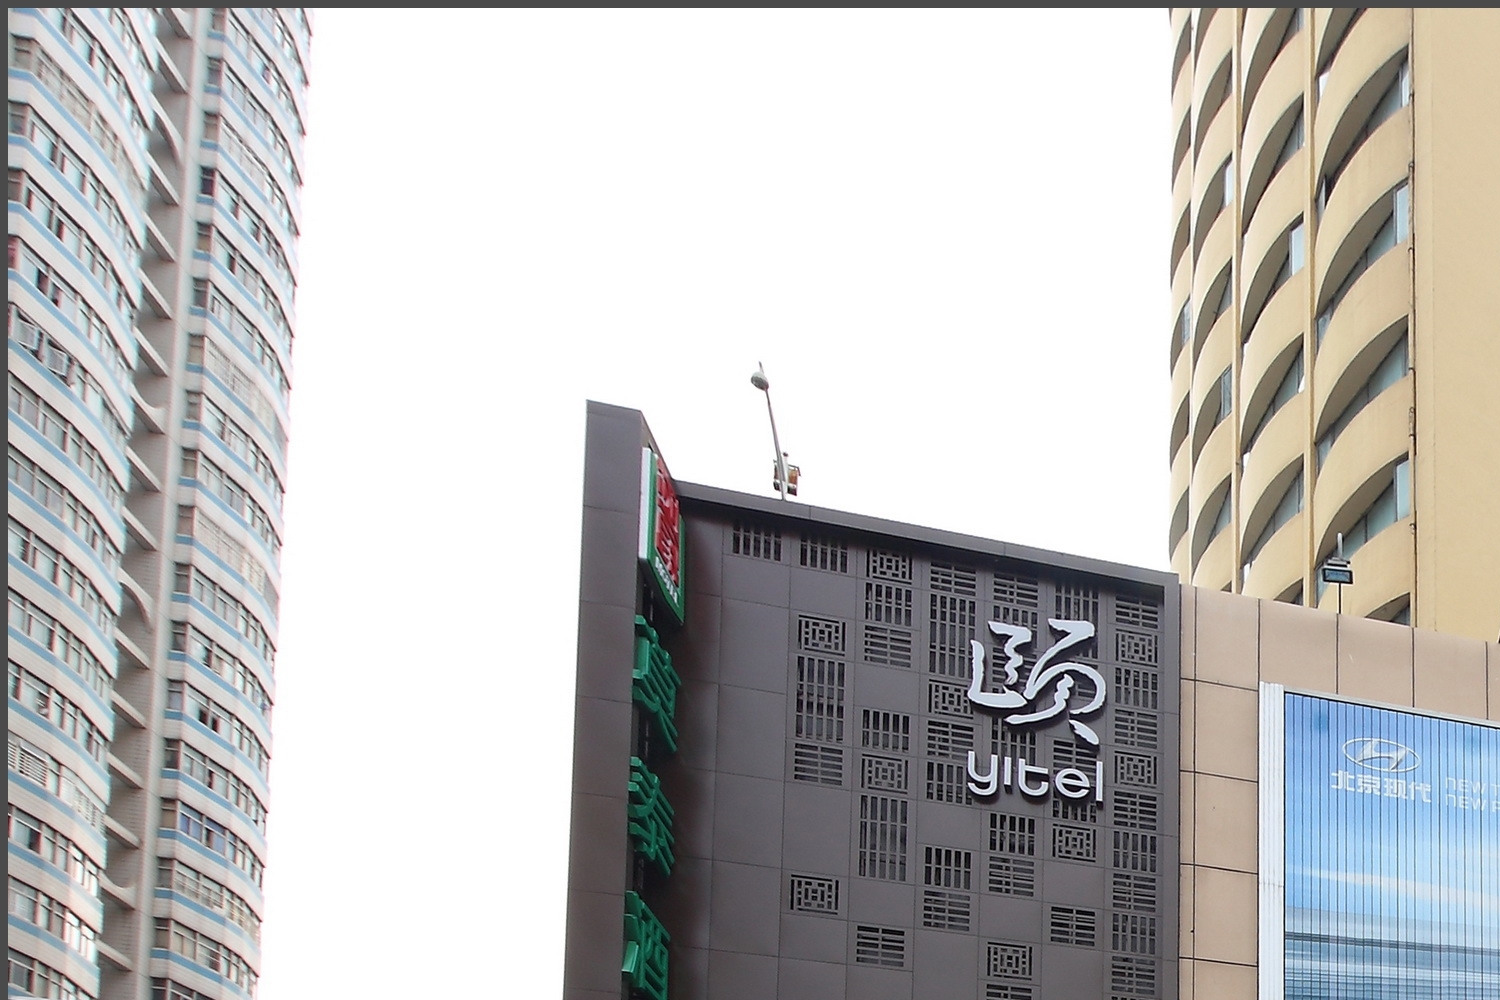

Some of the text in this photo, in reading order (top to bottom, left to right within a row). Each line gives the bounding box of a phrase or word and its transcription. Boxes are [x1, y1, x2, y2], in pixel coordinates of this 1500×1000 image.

[966, 751, 1104, 802] yitel
[1331, 770, 1431, 803] 北京现代
